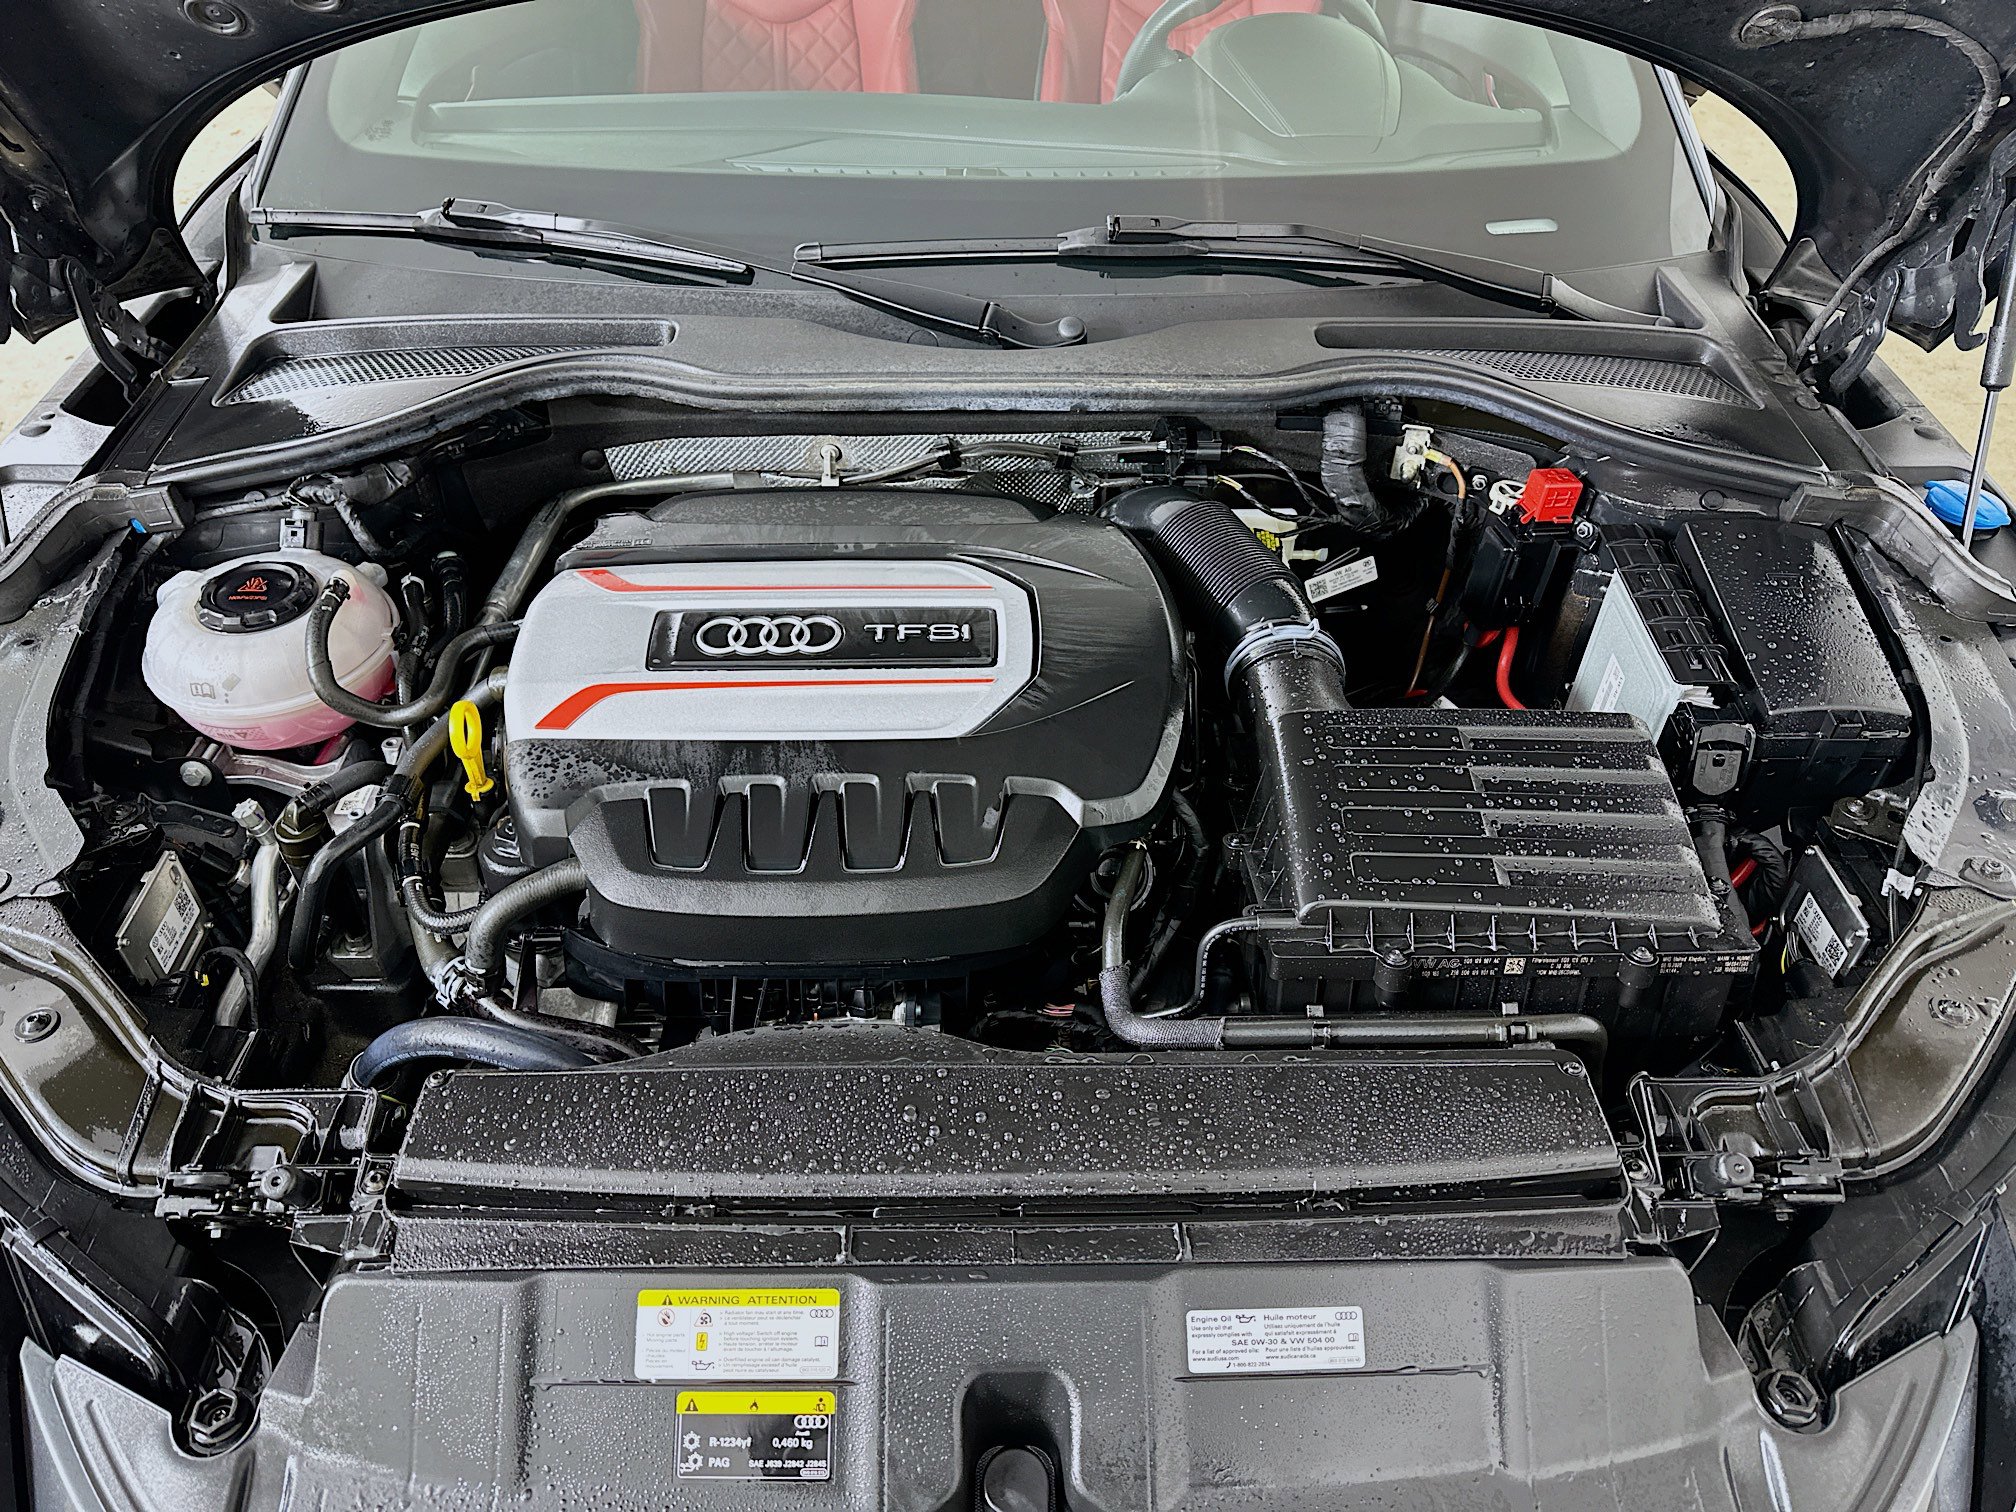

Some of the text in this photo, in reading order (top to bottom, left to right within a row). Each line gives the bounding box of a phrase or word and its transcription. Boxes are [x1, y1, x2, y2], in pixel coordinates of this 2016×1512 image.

[864, 623, 971, 643] TFSI
[1413, 958, 1461, 969] VW AG
[678, 1295, 817, 1305] WARNING ATTENTION
[709, 1437, 813, 1450] R-1234yf 0,460 kg
[708, 1458, 730, 1468] PAG
[748, 1460, 764, 1468] SAE
